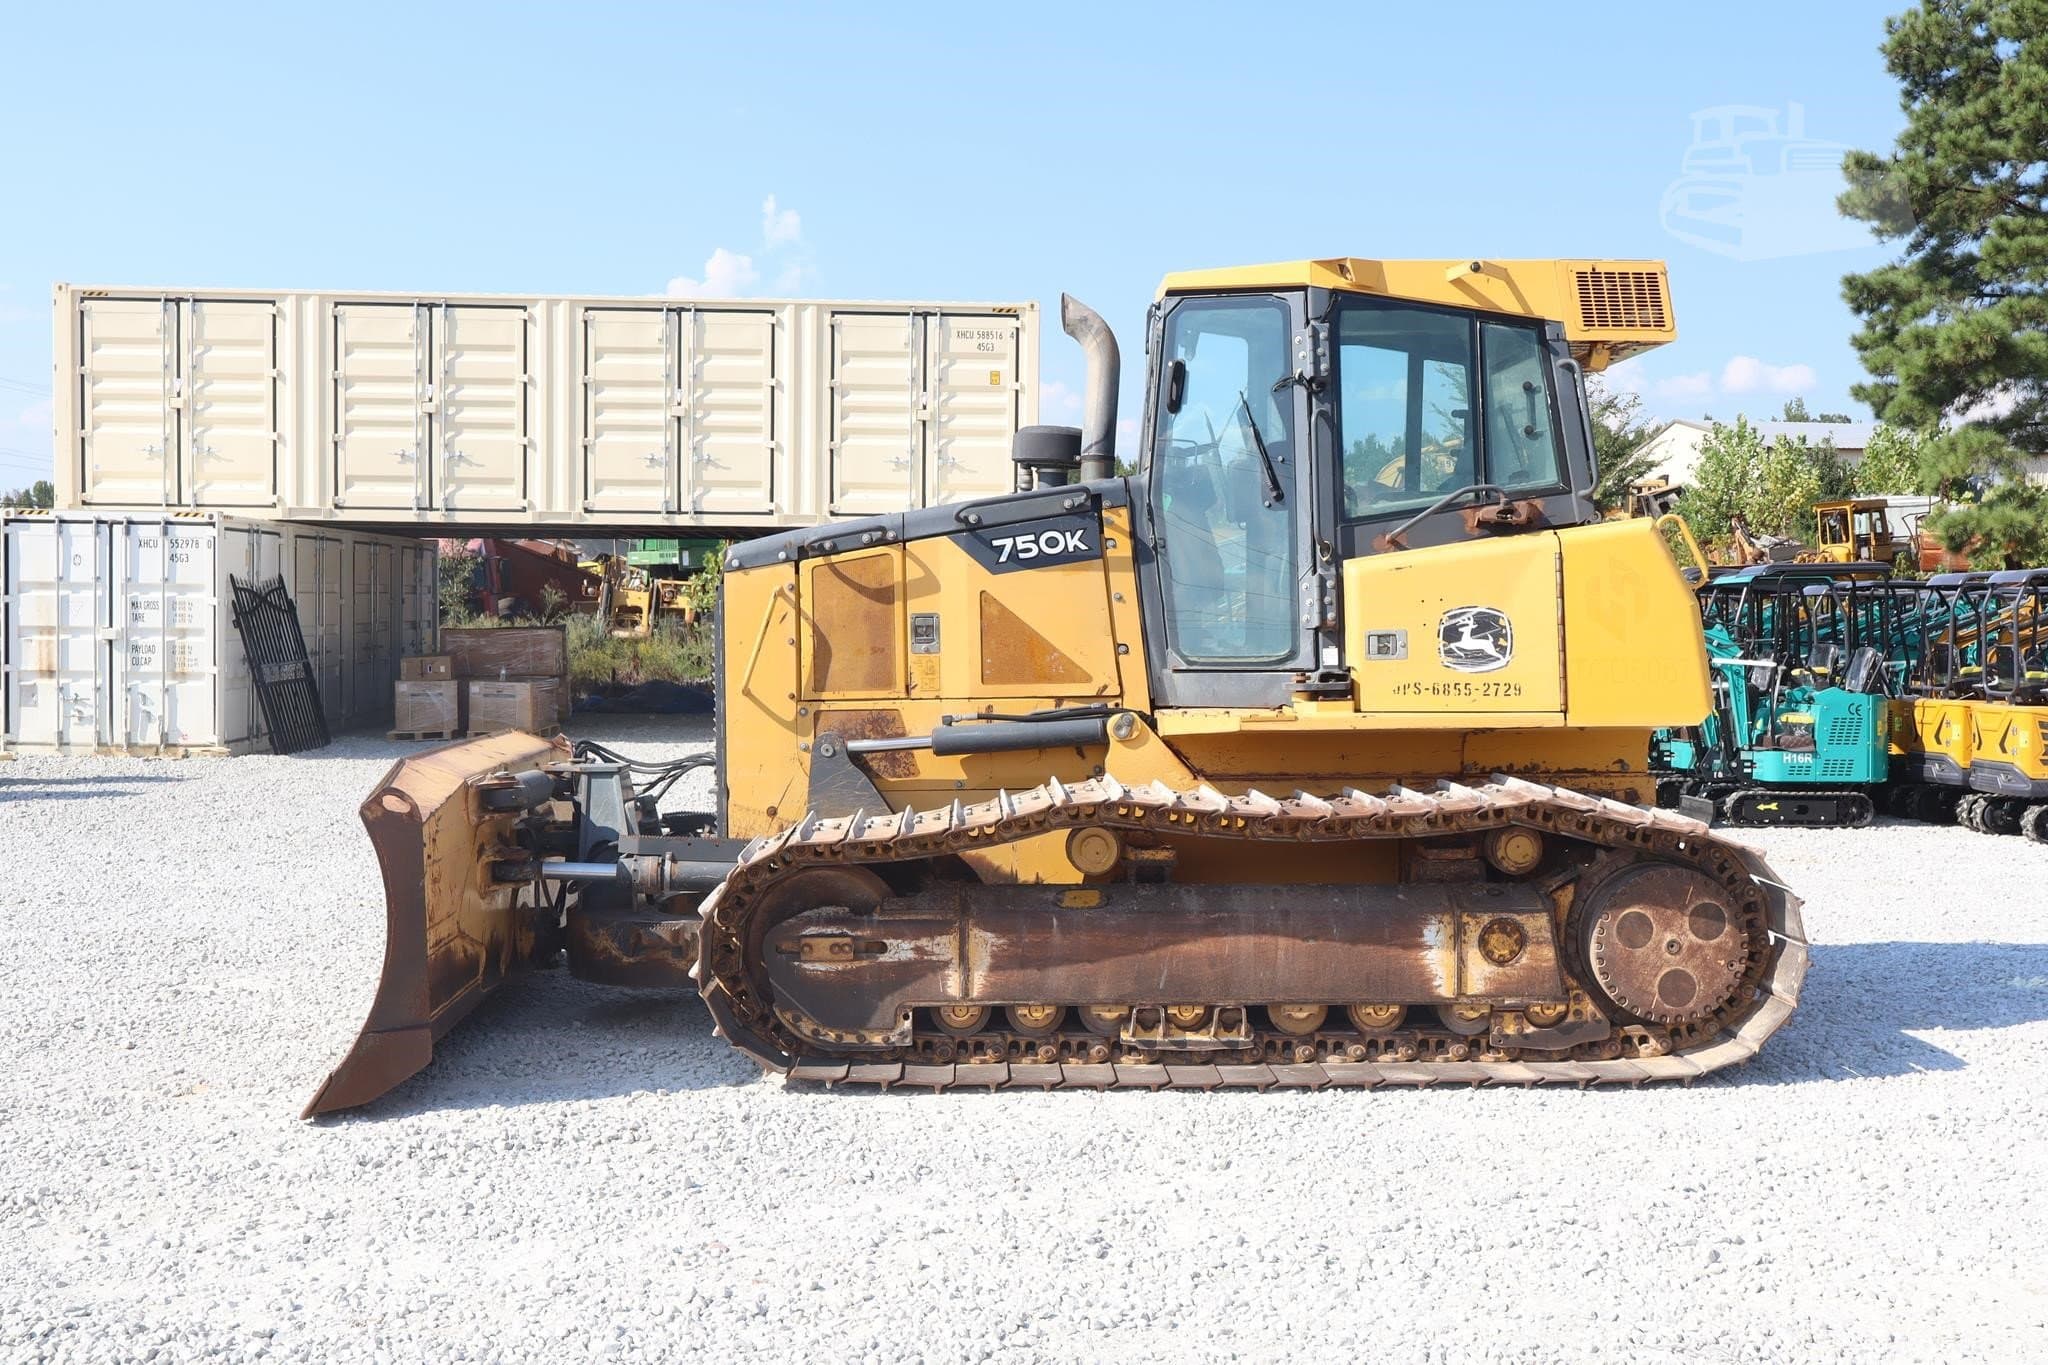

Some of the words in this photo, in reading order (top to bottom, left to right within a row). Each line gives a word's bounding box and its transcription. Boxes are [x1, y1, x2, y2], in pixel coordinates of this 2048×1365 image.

[956, 330, 974, 340] XHCU
[1009, 331, 1015, 339] 4
[976, 342, 994, 352] 45G3
[138, 538, 158, 549] XHCU
[169, 538, 200, 549] 552978
[991, 529, 1089, 562] 750K
[169, 553, 189, 564] 45G3
[131, 644, 156, 655] PAYLOAD
[1783, 753, 1814, 764] H16R
